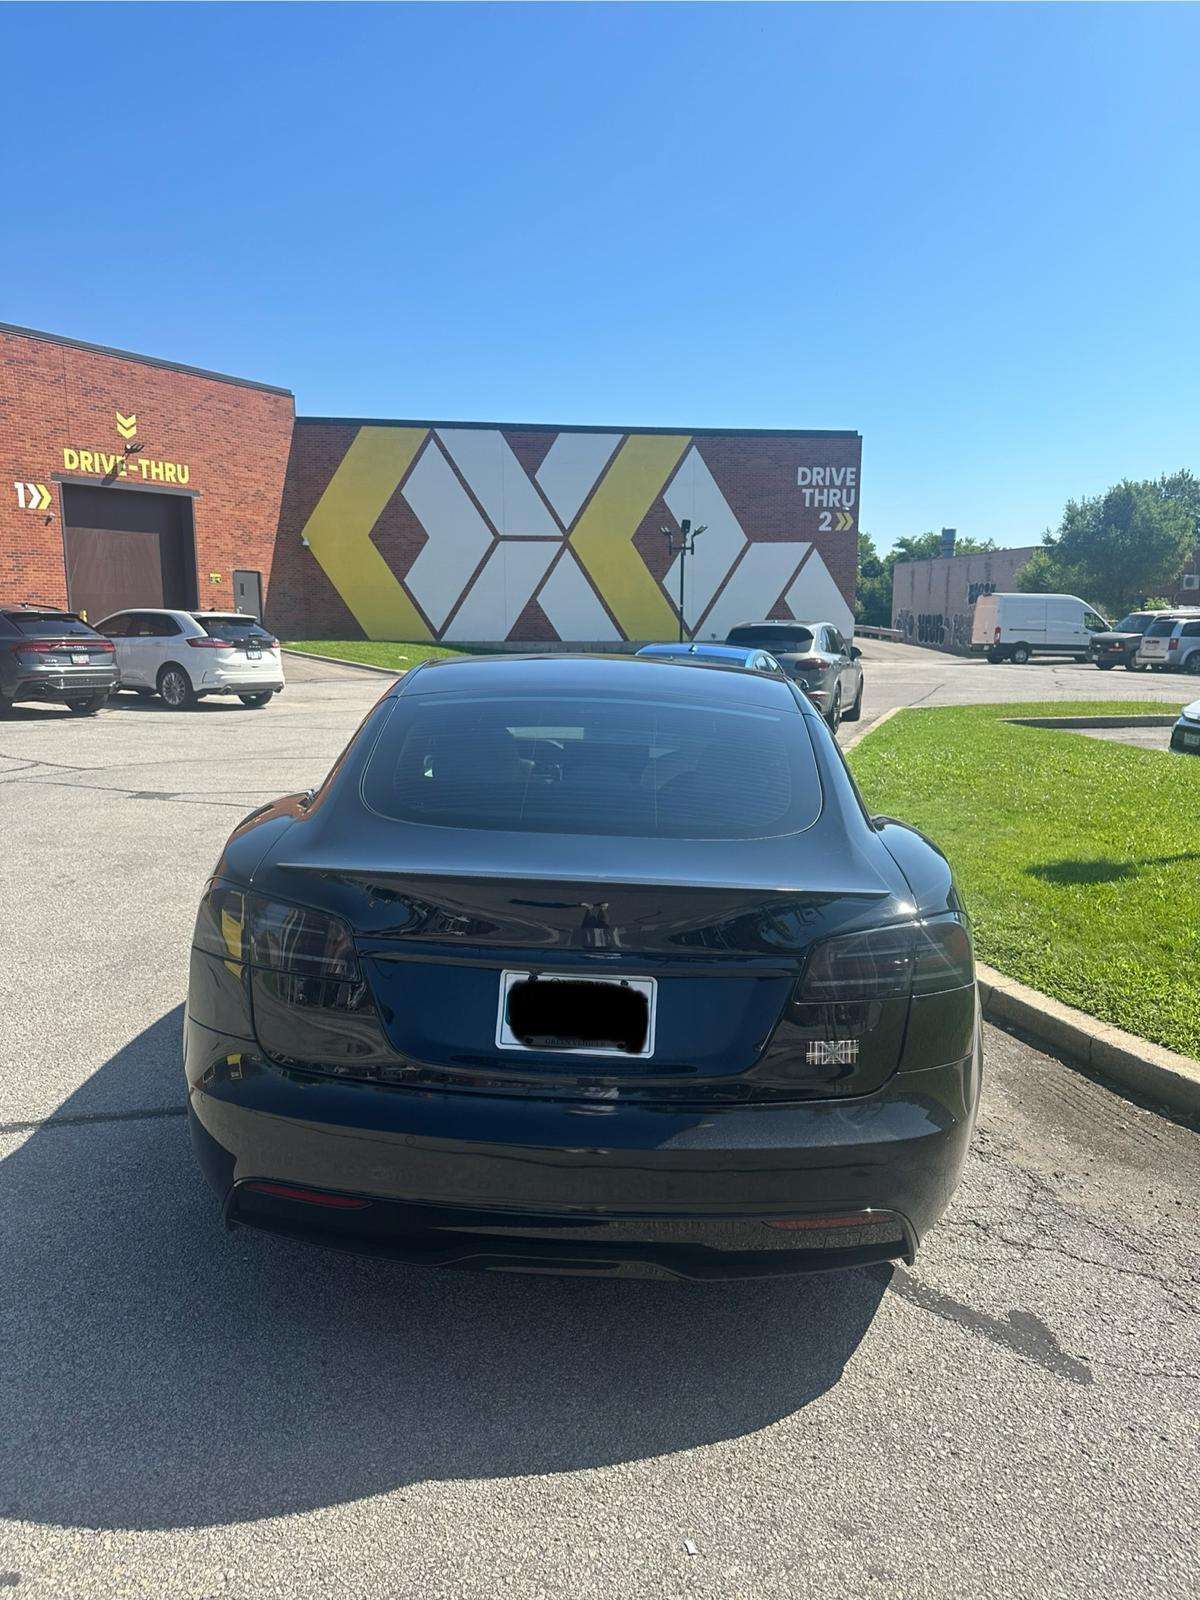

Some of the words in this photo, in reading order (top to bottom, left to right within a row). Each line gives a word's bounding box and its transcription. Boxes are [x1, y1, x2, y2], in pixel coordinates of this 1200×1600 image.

[63, 448, 190, 484] DRIVE-THRU
[797, 466, 857, 486] DRIVE
[14, 481, 26, 508] 1
[801, 488, 856, 507] THRU
[818, 511, 832, 531] 2
